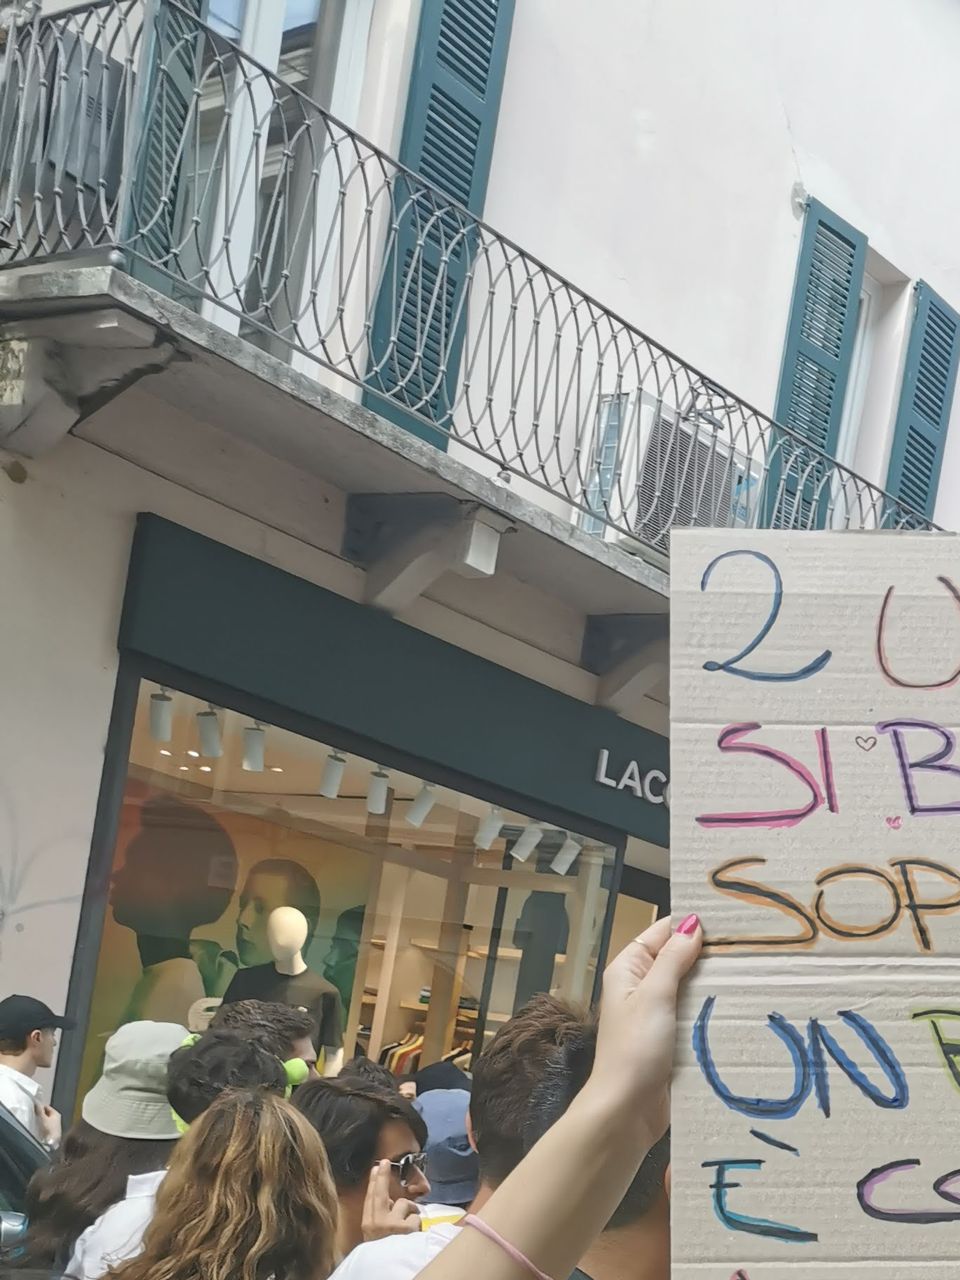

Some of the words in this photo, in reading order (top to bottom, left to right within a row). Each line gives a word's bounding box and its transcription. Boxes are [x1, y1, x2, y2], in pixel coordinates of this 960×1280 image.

[702, 549, 832, 681] 2
[596, 748, 670, 808] LAC
[695, 721, 838, 829] SI
[692, 995, 909, 1120] UN
[701, 1126, 819, 1244] È
